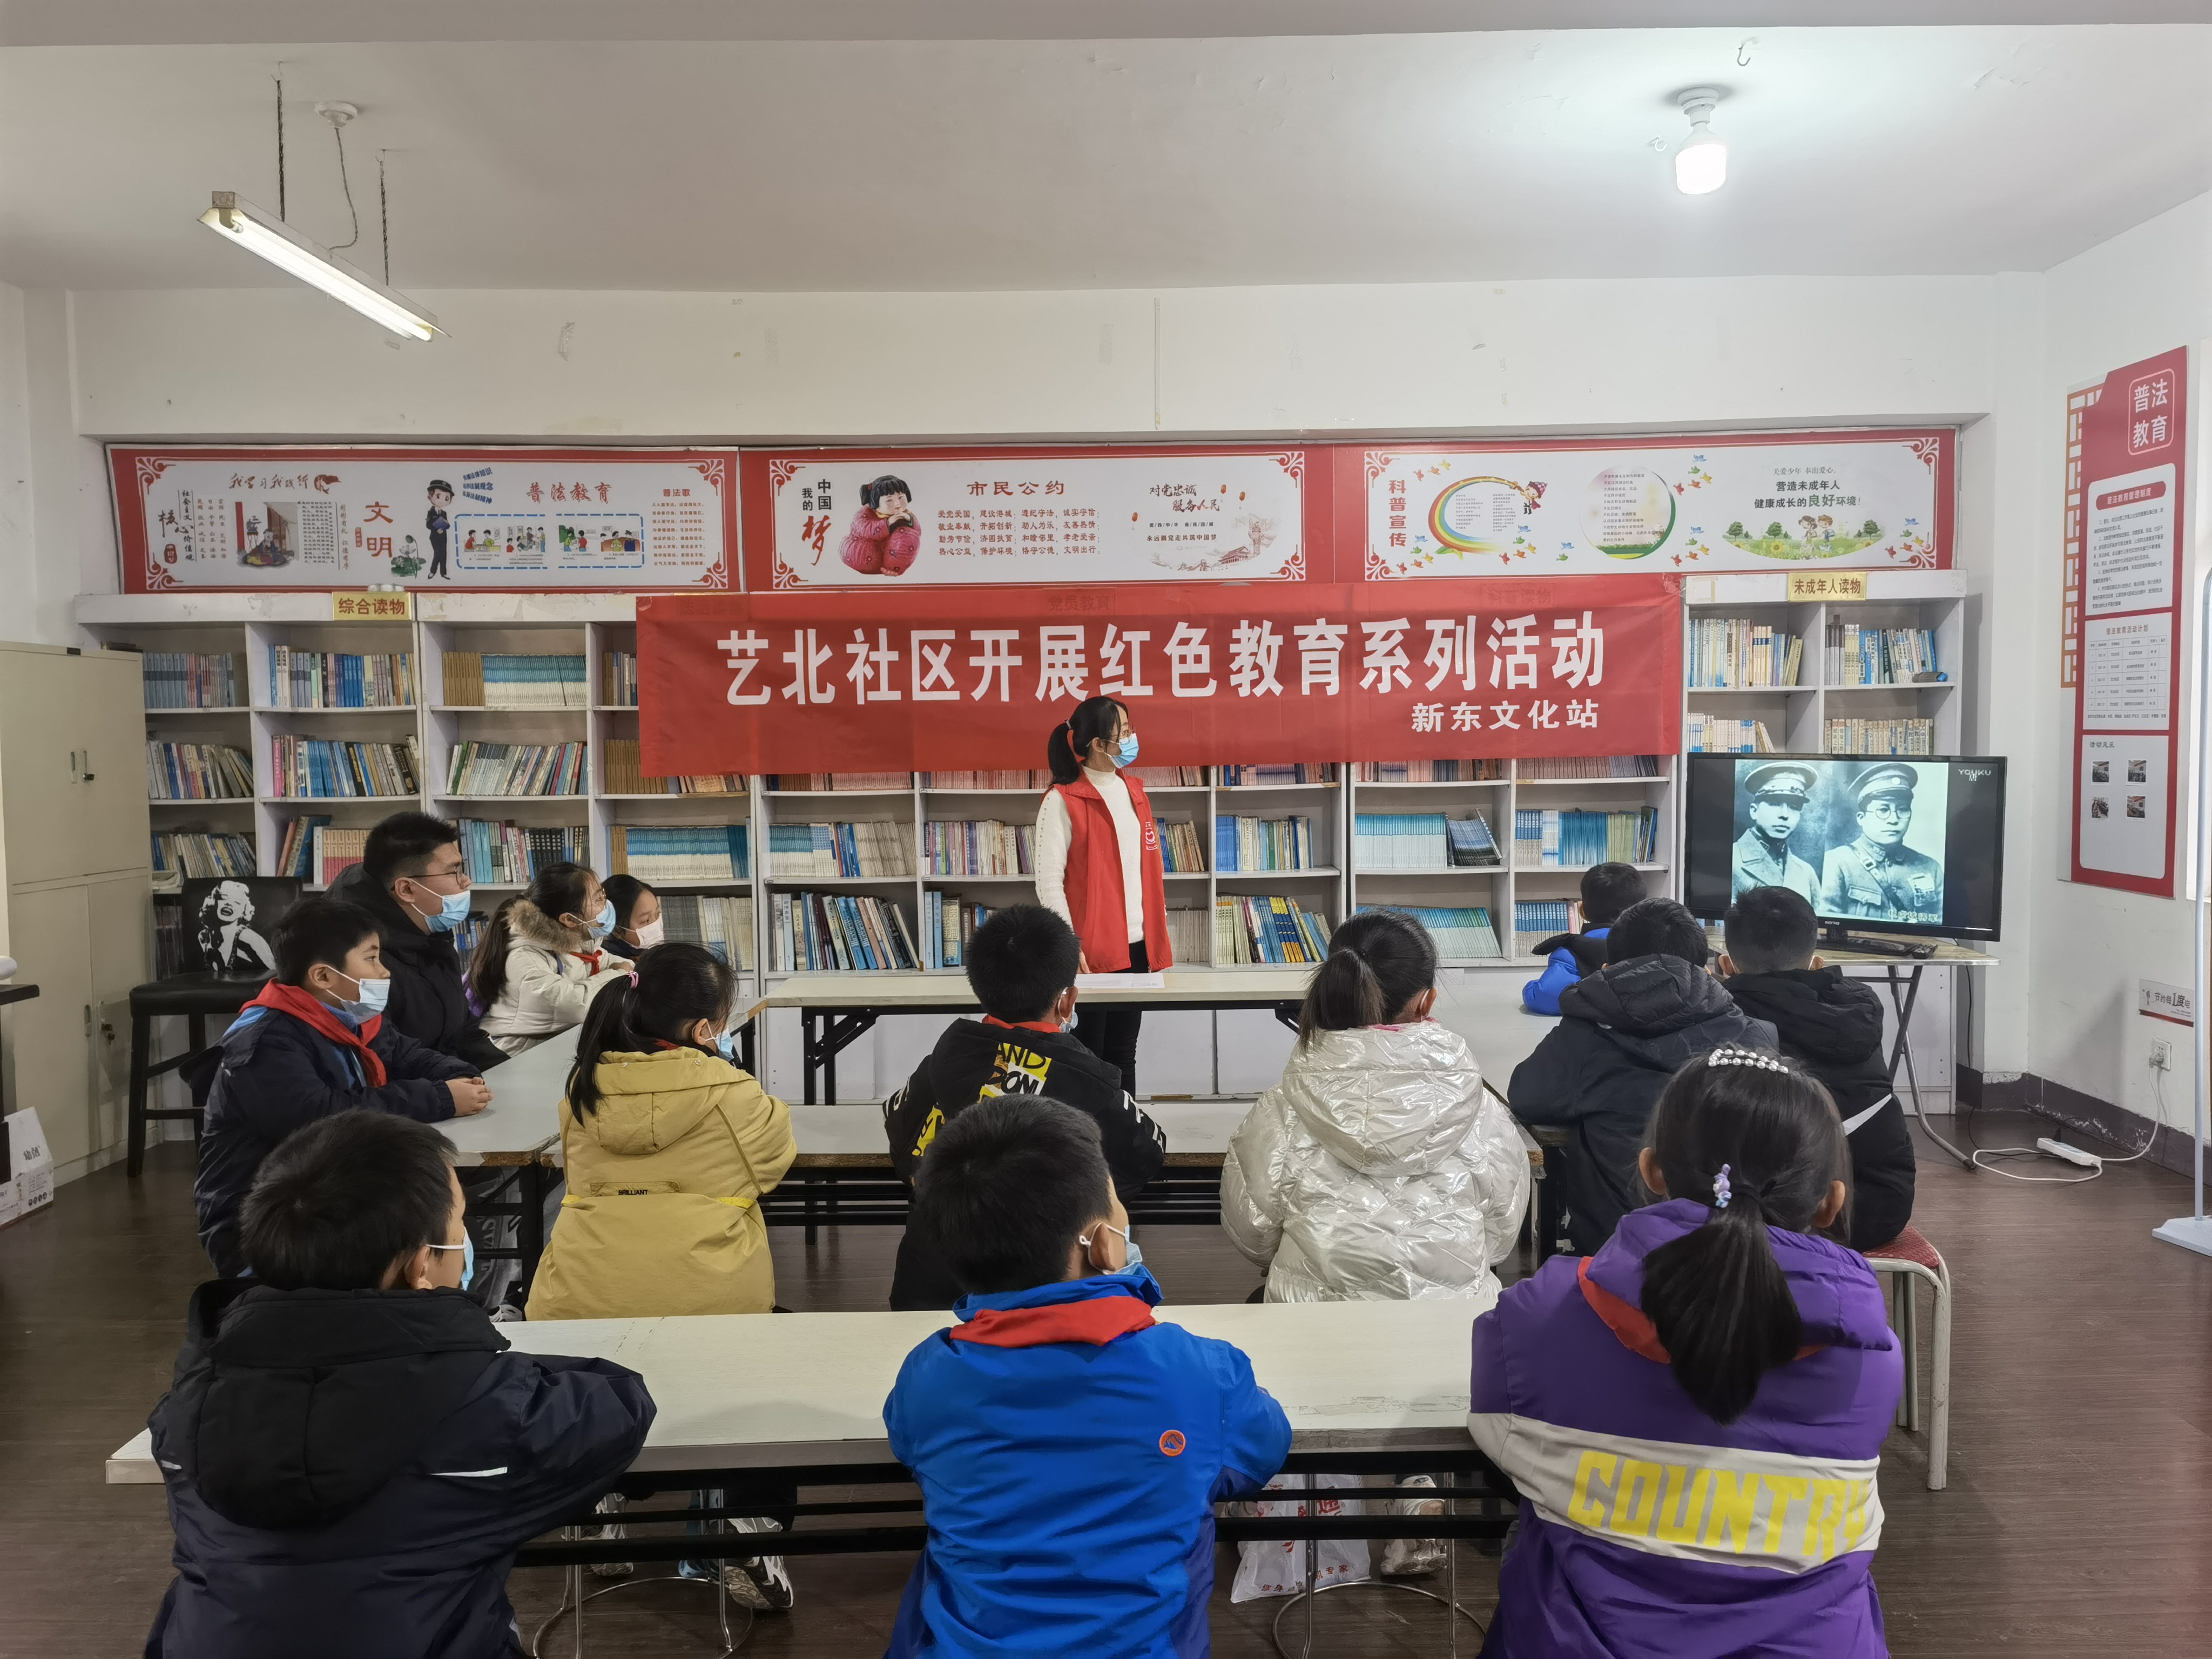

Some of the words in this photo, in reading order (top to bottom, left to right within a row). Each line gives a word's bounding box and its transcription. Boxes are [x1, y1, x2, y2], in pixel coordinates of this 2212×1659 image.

[2134, 378, 2168, 413] 普法
[2133, 415, 2167, 449] 教育
[527, 482, 611, 504] 普法教育
[663, 489, 690, 497] 普法歌
[802, 487, 813, 511] 我的
[818, 479, 832, 510] 中国
[967, 481, 1064, 496] 市民公约
[1149, 483, 1197, 497] 对党忠诚
[1776, 480, 1840, 492] 营造未成年人
[1172, 498, 1220, 512] 服务人民
[1388, 479, 1406, 547] 科普宣传
[363, 501, 393, 558] 文明
[801, 515, 832, 566] 梦
[1793, 578, 1862, 595] 未成年人读物
[338, 598, 406, 615] 综合读物
[717, 611, 1604, 706] 艺北社区开展红色教育系列活动
[1411, 698, 1600, 733] 新东文化站
[1568, 1451, 1869, 1562] COUNTRY
